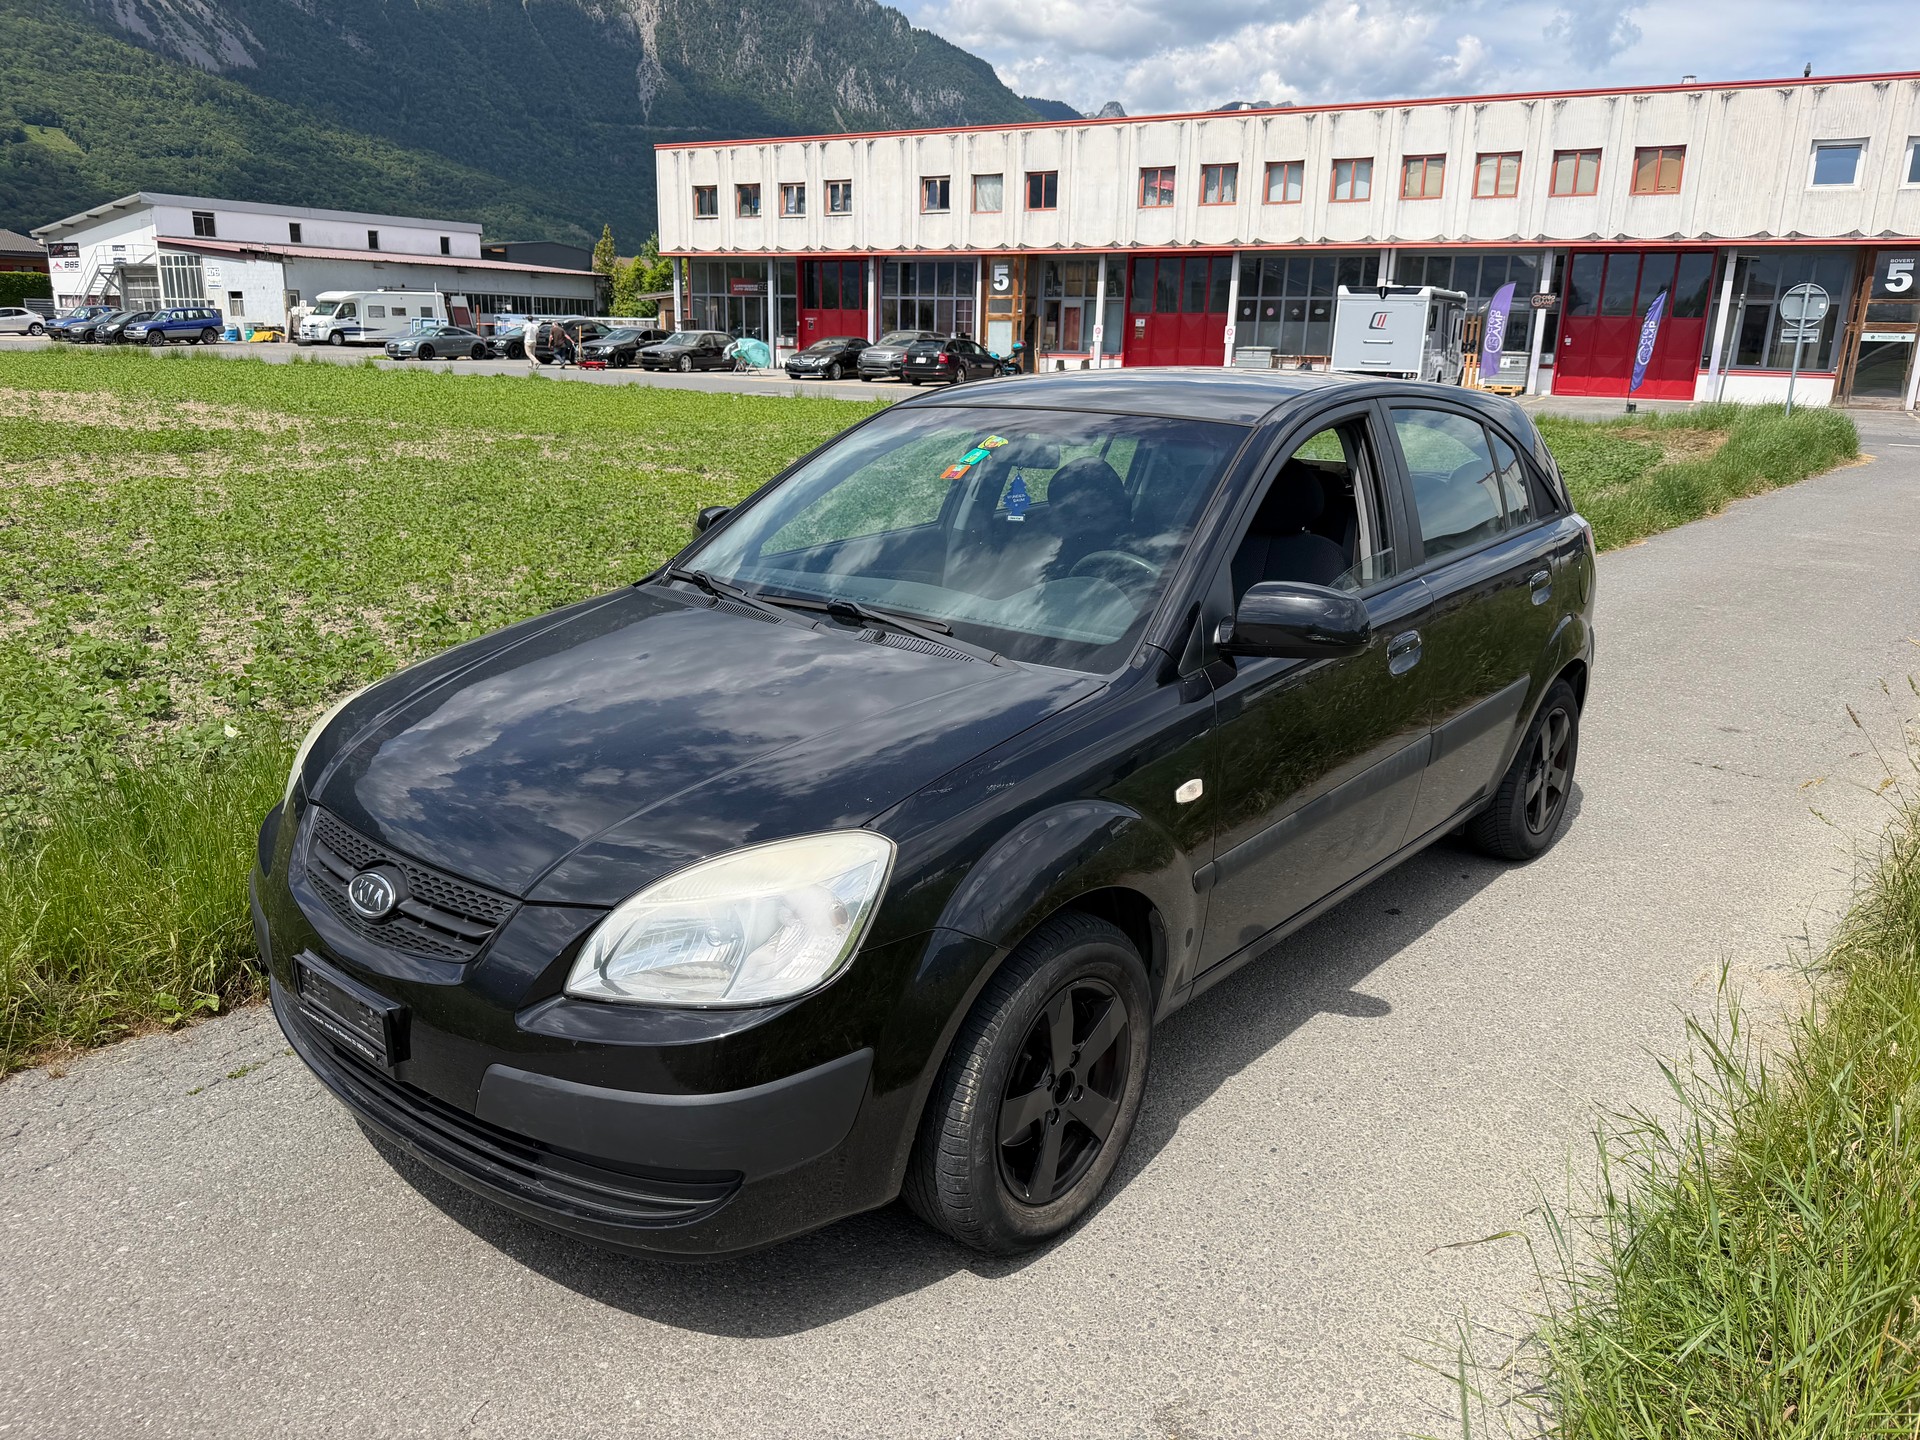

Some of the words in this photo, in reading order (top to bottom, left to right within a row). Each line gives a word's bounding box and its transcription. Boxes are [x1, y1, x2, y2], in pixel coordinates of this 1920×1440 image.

[993, 268, 1010, 291] 5
[1884, 263, 1914, 293] 5
[353, 878, 385, 911] KIA
